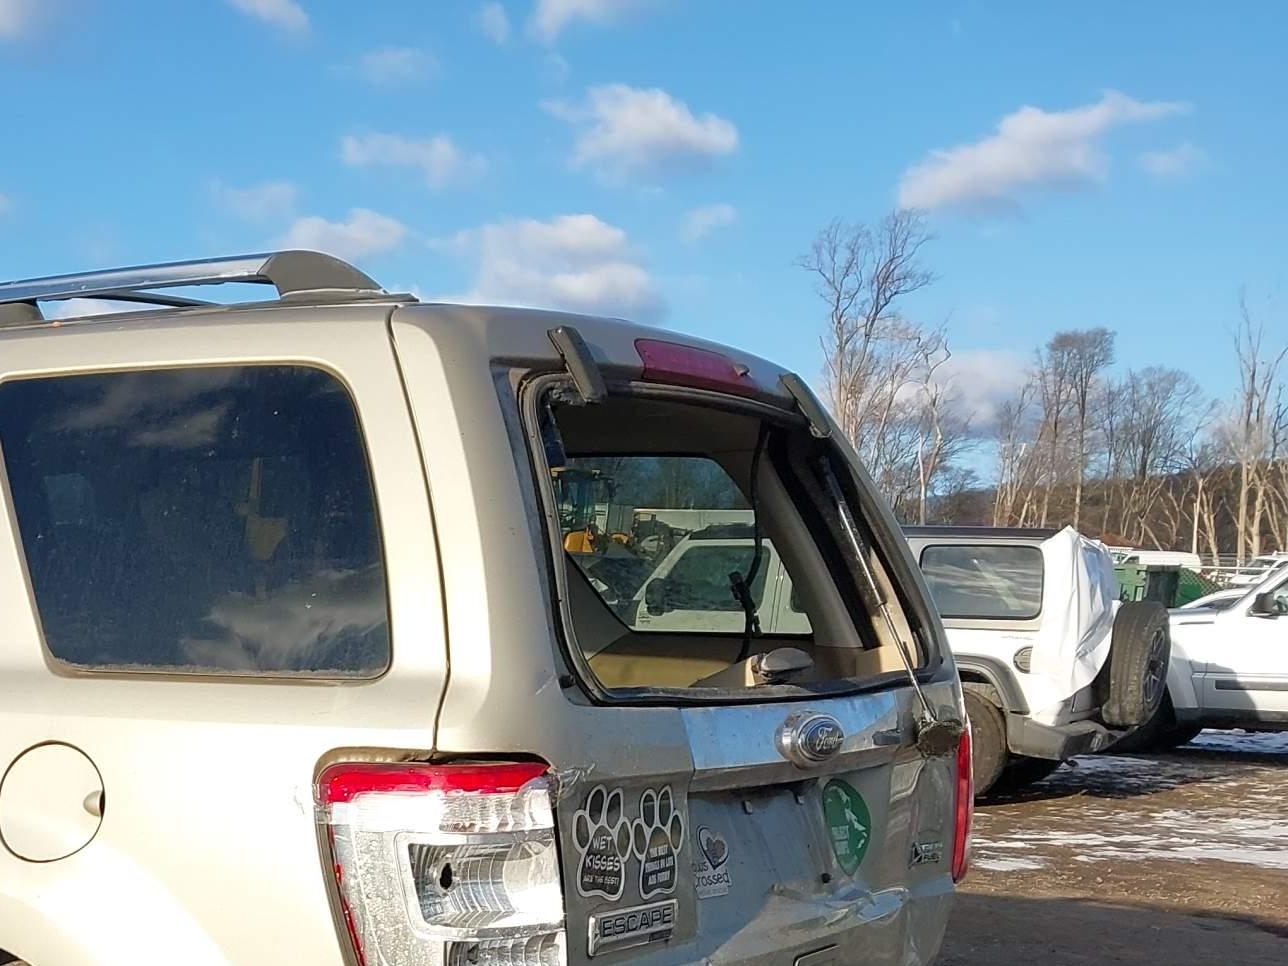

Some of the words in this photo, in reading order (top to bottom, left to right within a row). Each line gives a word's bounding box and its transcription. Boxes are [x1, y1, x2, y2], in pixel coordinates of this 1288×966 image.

[816, 727, 843, 751] Ford
[592, 836, 613, 851] WET
[585, 854, 621, 871] KISSES
[602, 907, 672, 937] ESCAPE
